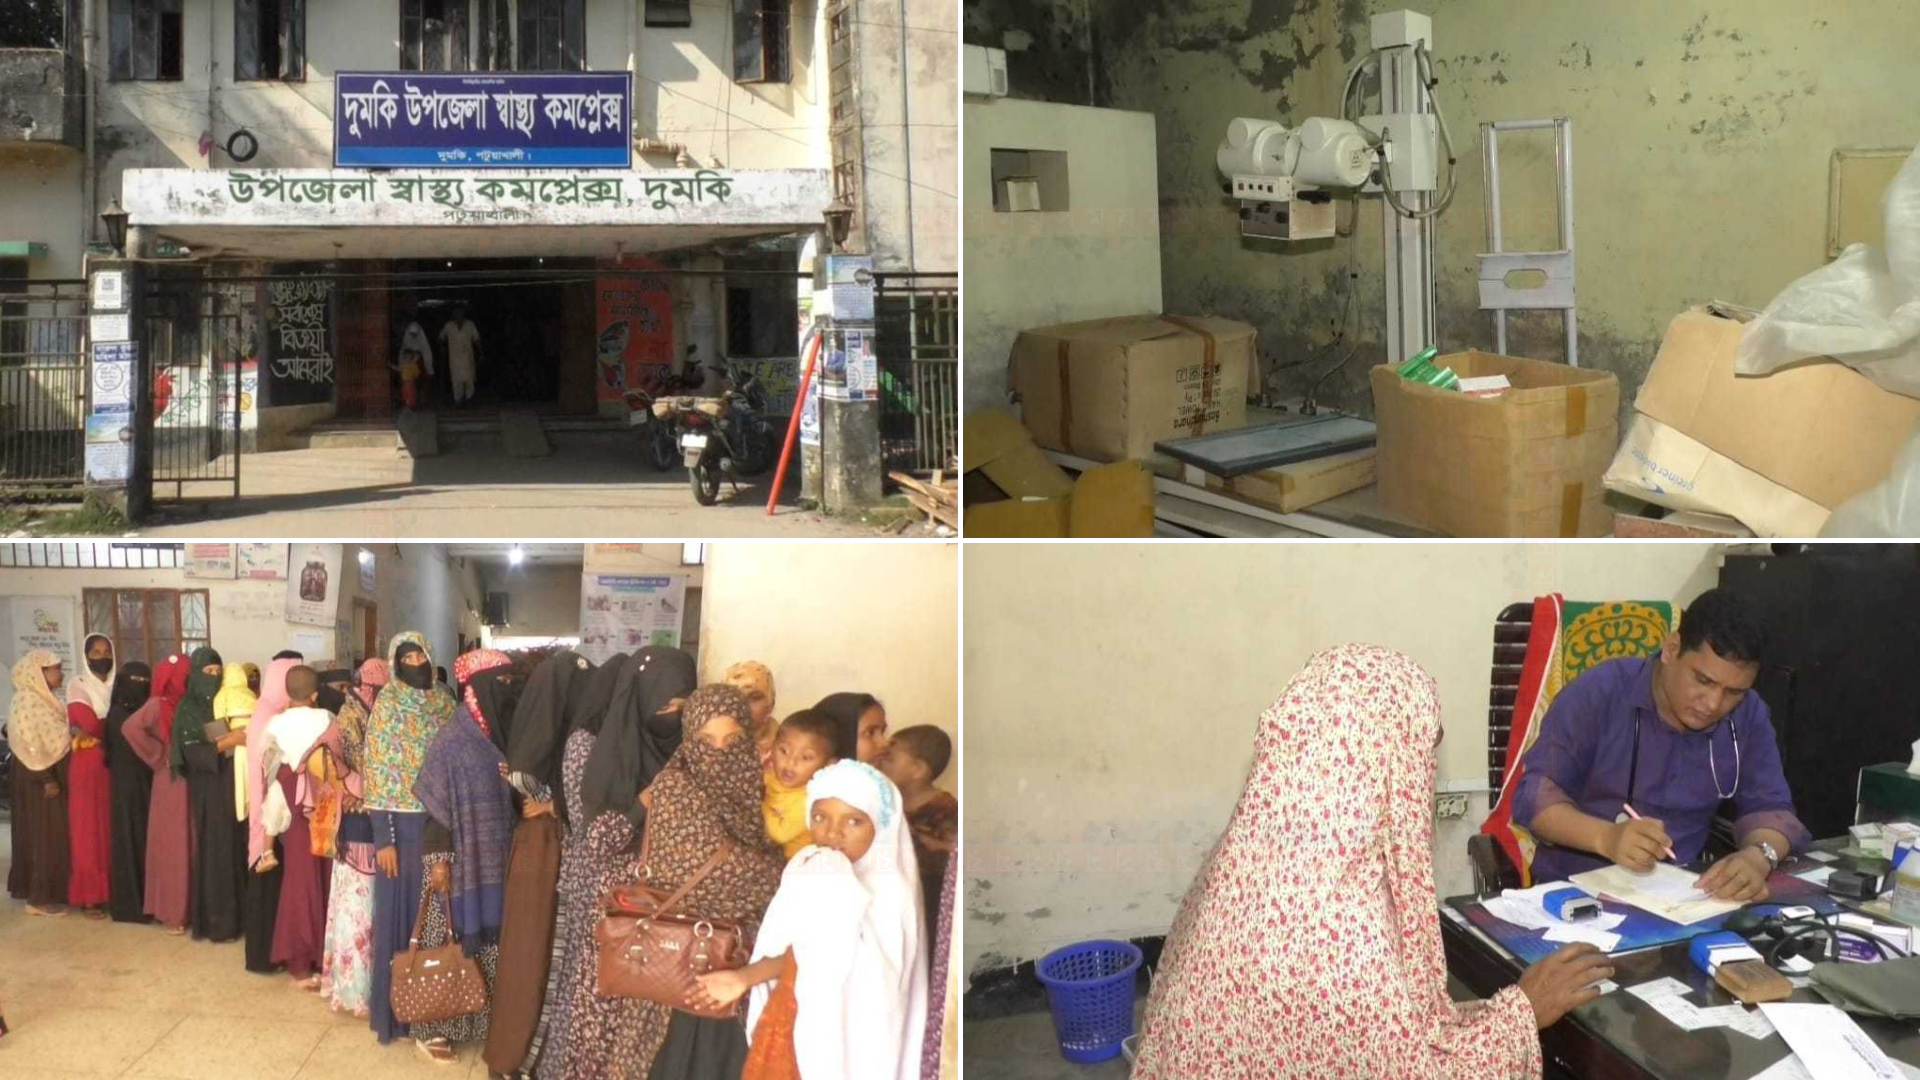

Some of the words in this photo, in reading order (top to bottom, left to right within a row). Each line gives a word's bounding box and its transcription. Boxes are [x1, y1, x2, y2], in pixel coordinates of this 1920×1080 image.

[342, 79, 399, 139] দুমকি
[403, 82, 489, 130] উপজেলা
[492, 90, 538, 139] স্বাস্থ্য
[541, 90, 624, 134] কমপ্লেক্স
[228, 170, 378, 204] উপজেলা
[387, 174, 466, 209] স্বাস্থ্য
[474, 174, 633, 207] কমপ্লেক্স,
[640, 169, 734, 210] দুমকি
